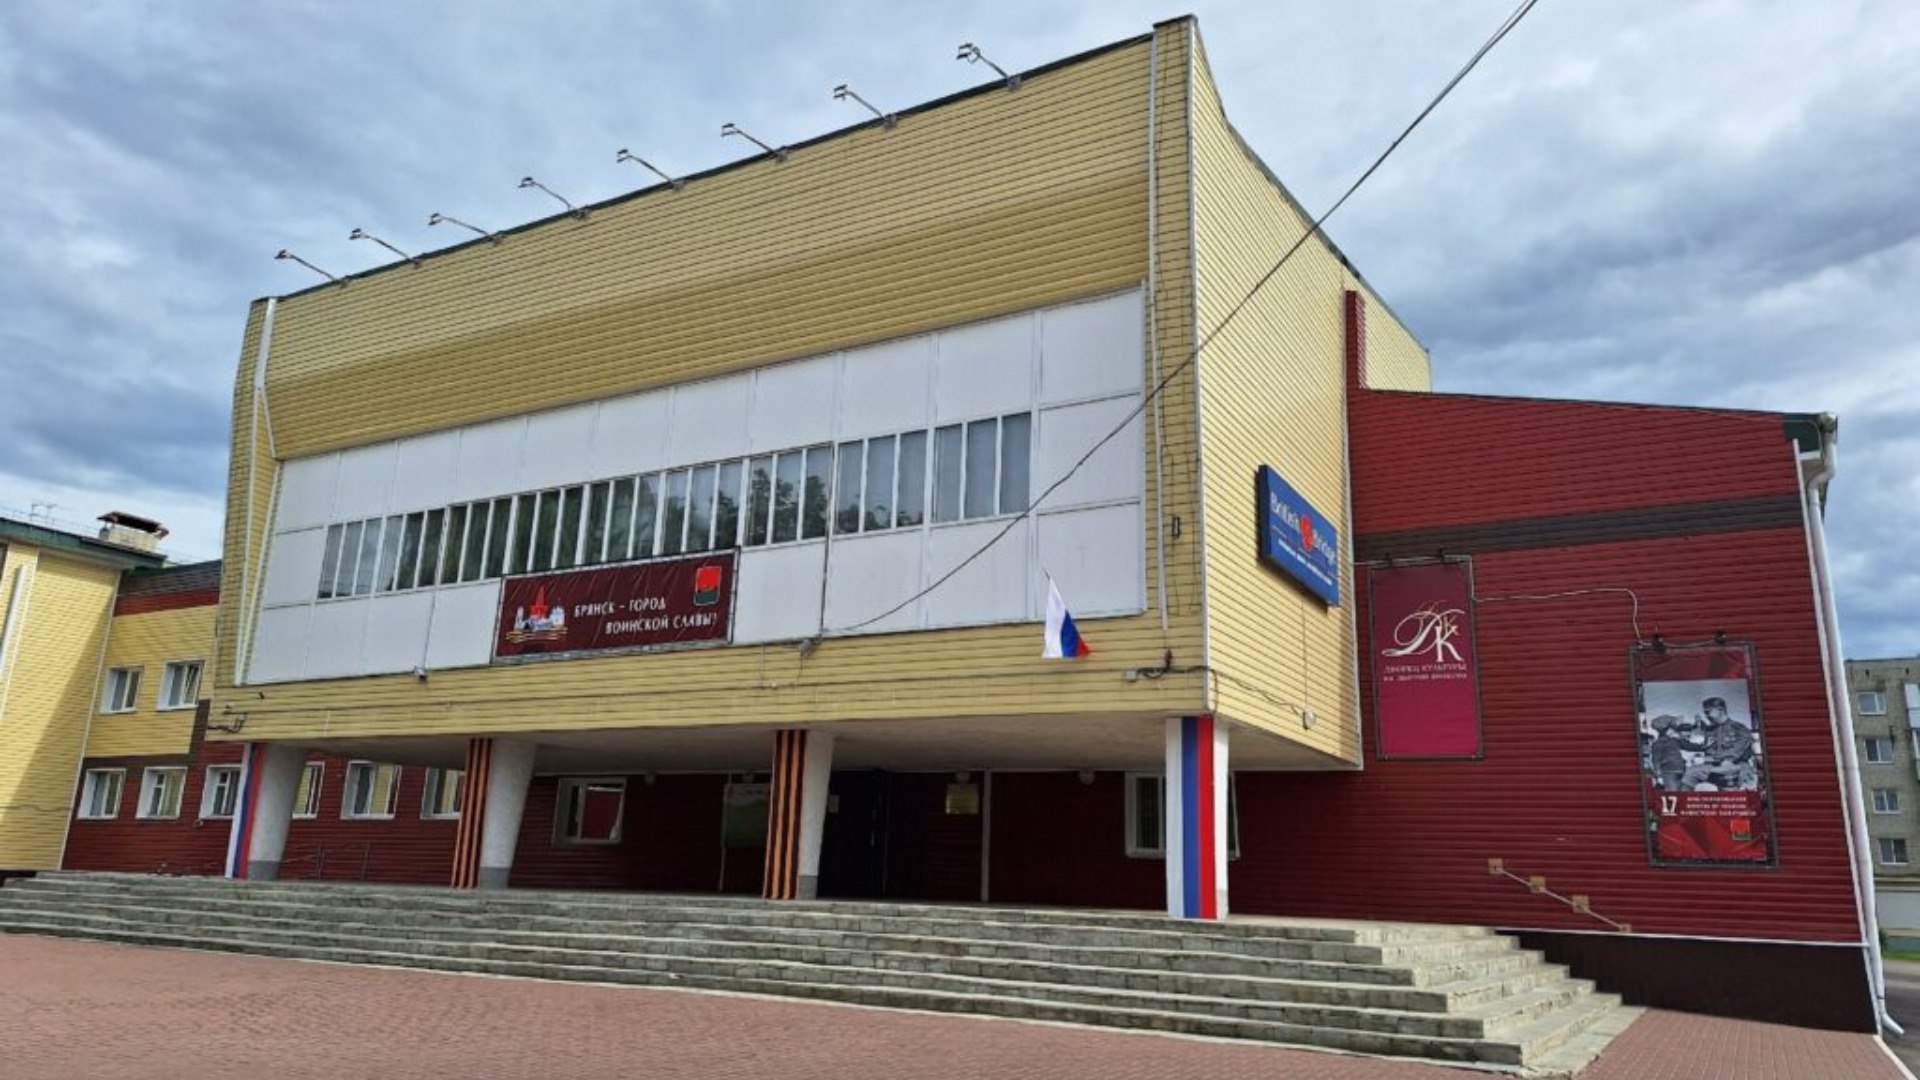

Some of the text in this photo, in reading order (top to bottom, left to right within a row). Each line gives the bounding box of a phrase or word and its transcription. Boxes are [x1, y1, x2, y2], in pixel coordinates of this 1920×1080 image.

[574, 602, 615, 617] БРЯНСК
[629, 597, 666, 611] ГОРОД
[605, 616, 669, 635] ВОИНСКОЙ
[1661, 796, 1677, 814] 17
